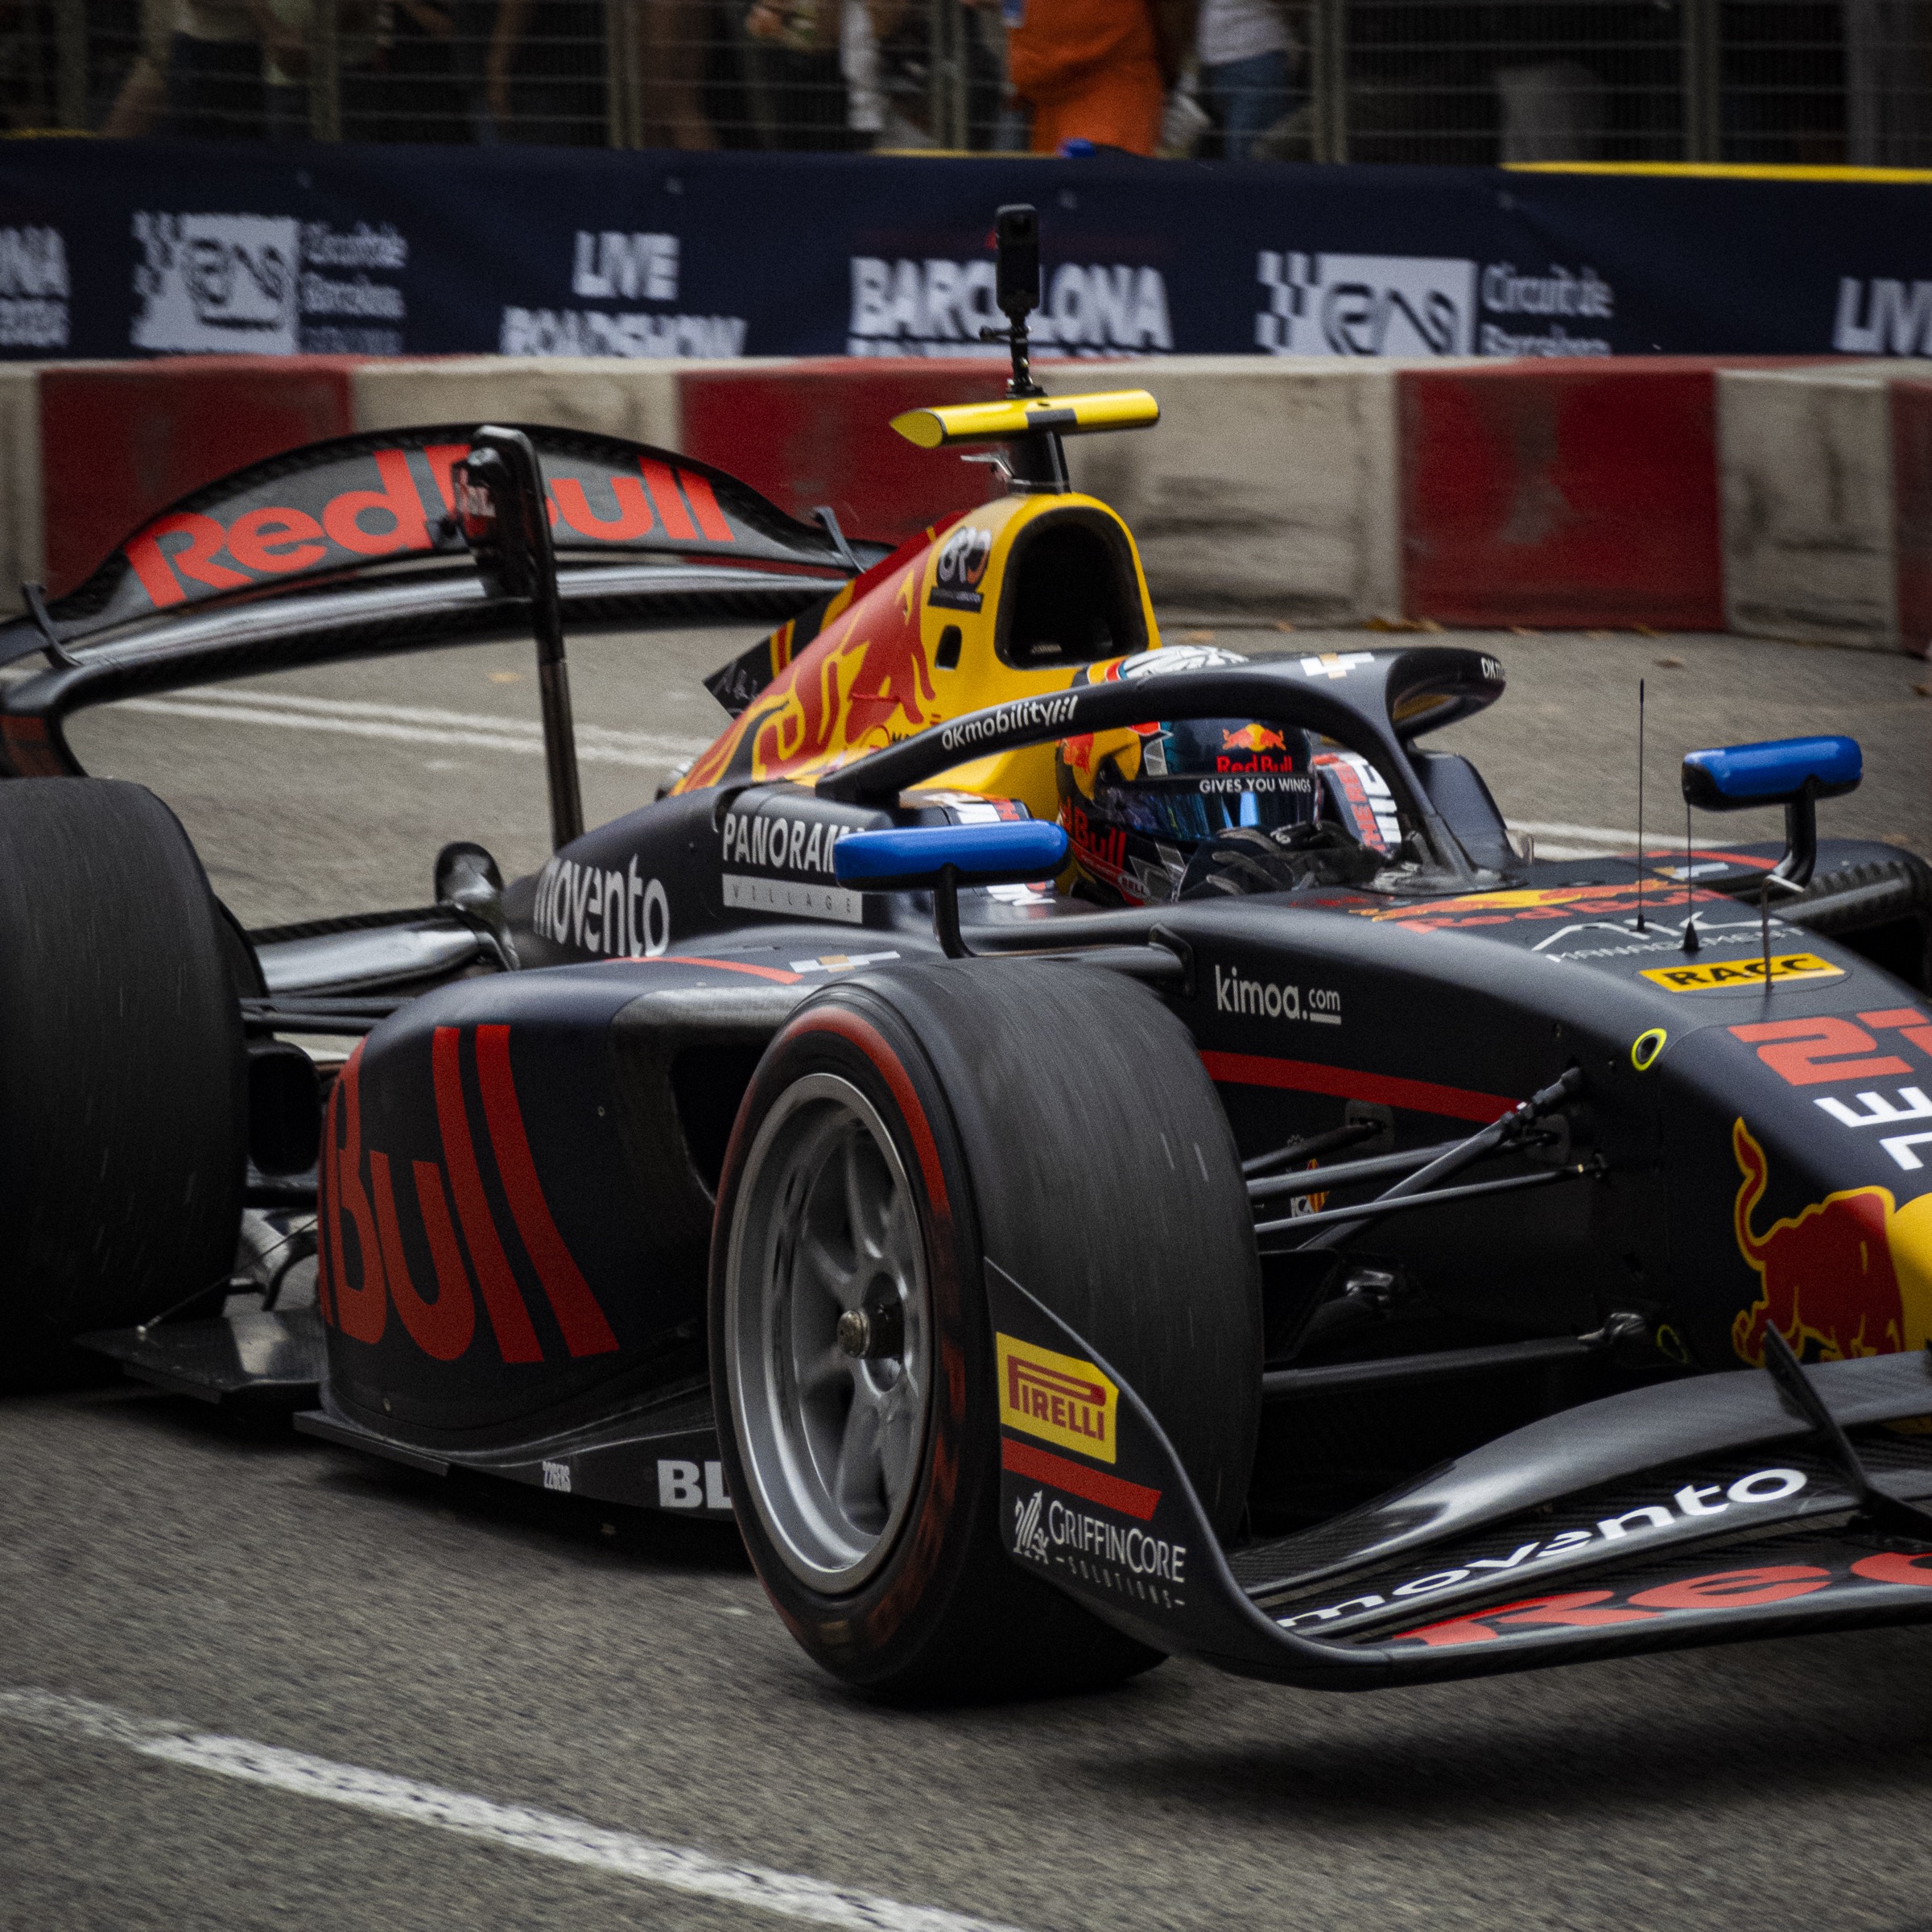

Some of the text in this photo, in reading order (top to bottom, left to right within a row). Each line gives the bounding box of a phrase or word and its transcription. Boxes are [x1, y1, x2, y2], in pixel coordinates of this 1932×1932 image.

[848, 258, 1174, 349] BARCLONA
[124, 449, 433, 608] Red
[1199, 777, 1311, 793] GIVES YOU WINGS
[1216, 754, 1258, 773] Red
[723, 813, 865, 873] PANORAM
[533, 853, 670, 958] movento
[732, 884, 853, 915] VILLAGE
[1215, 964, 1342, 1025] kimoa.com
[1662, 958, 1825, 985] RACC
[1007, 1354, 1107, 1442] PIRELLI
[1278, 1468, 1808, 1628] movento
